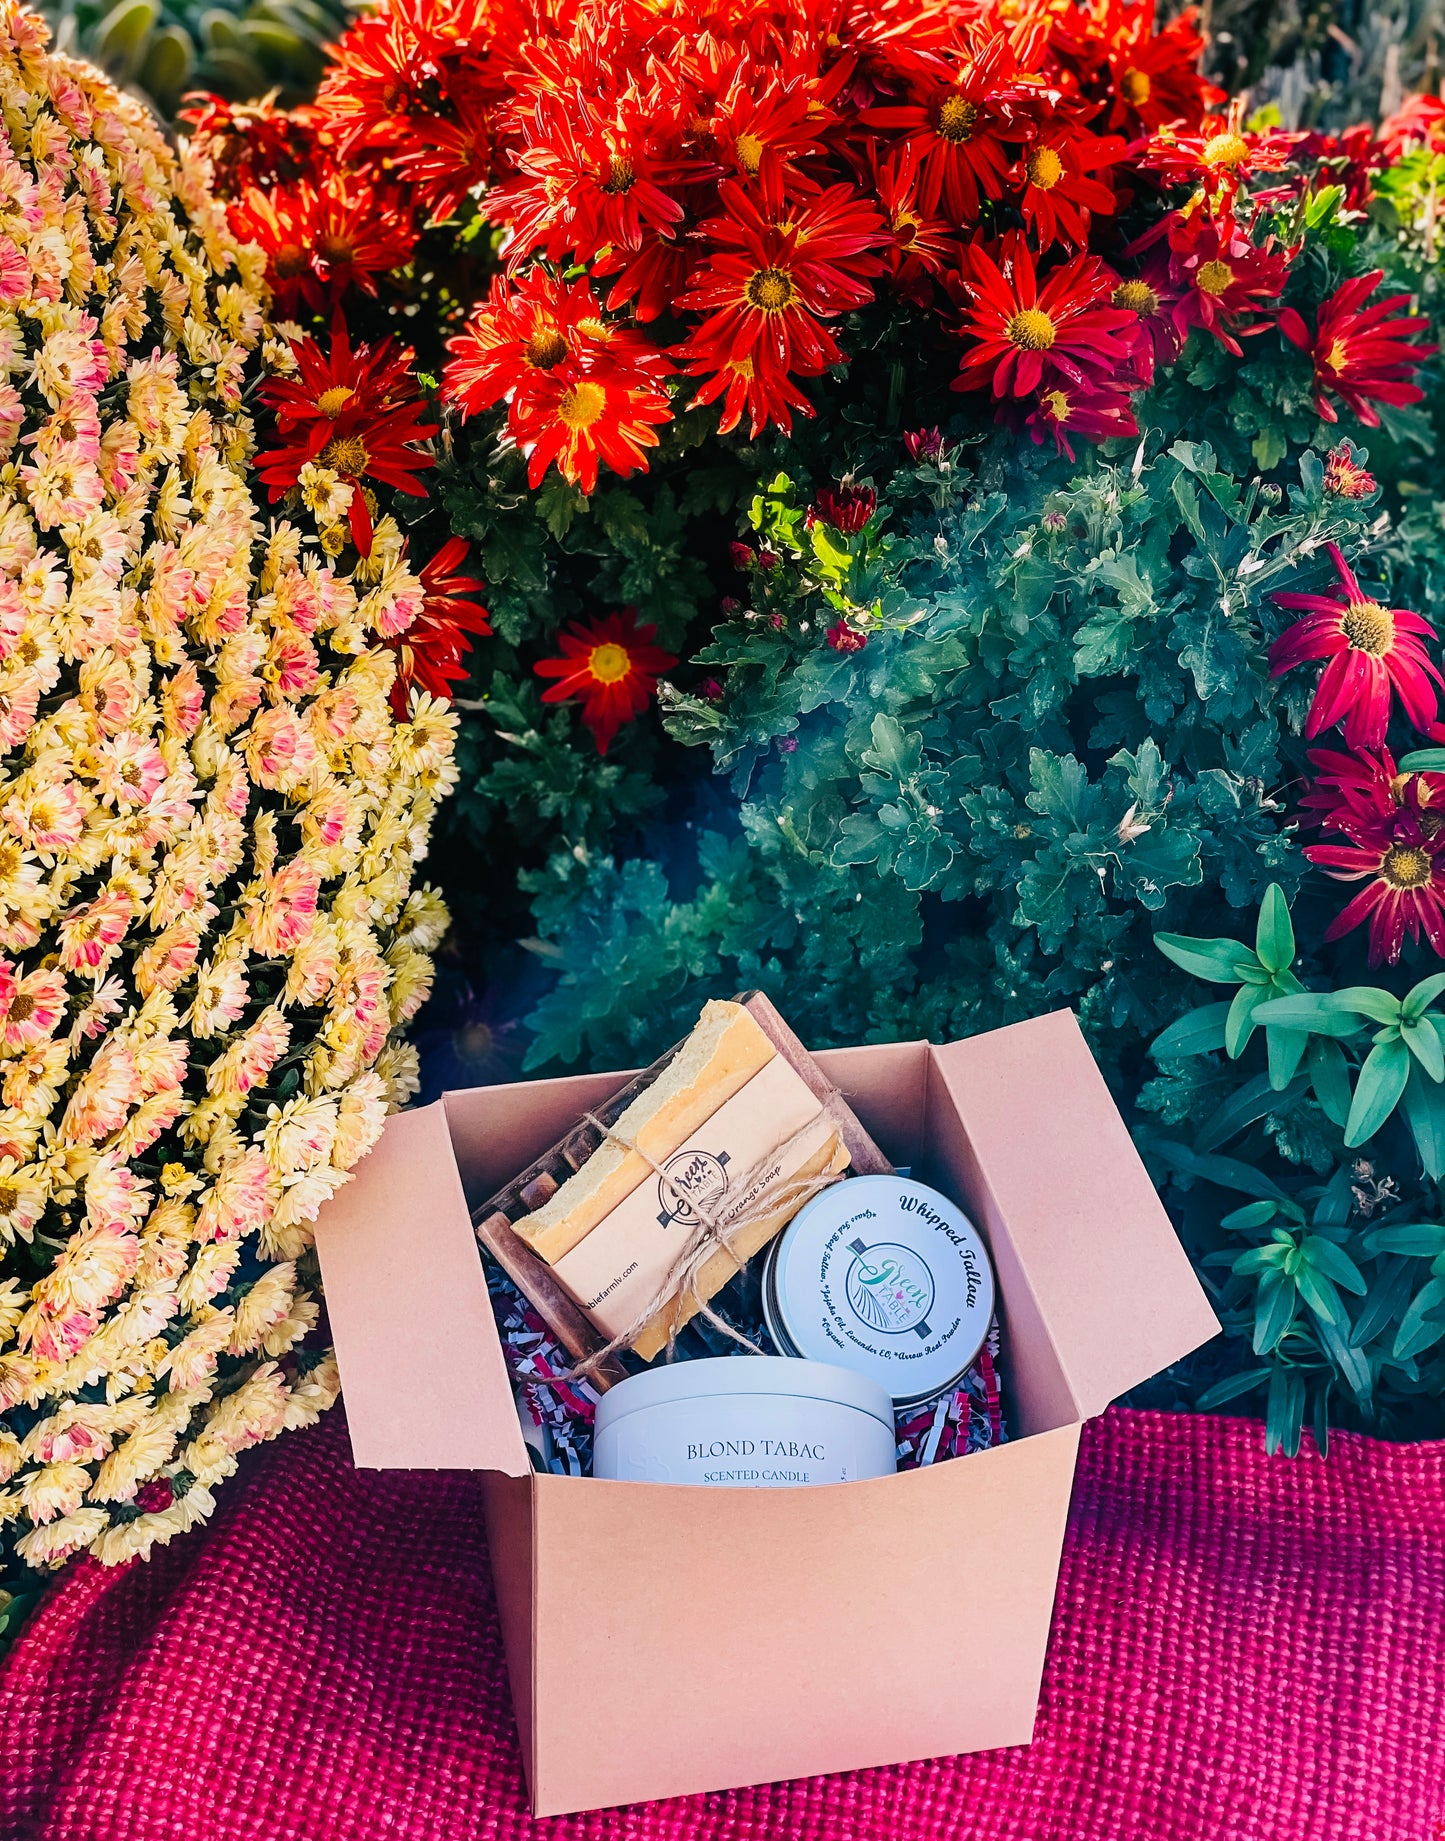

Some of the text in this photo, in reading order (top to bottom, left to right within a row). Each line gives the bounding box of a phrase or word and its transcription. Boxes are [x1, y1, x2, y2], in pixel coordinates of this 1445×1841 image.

[728, 1165, 781, 1218] Orange Soap
[899, 1195, 982, 1309] Whipped Tallow
[879, 1283, 910, 1323] TABLE
[845, 1330, 878, 1354] Lavender
[924, 1341, 942, 1355] Root
[941, 1317, 961, 1344] Powder
[687, 1440, 825, 1460] BLOND TABAC
[703, 1470, 810, 1483] SCENTED CANDLE
